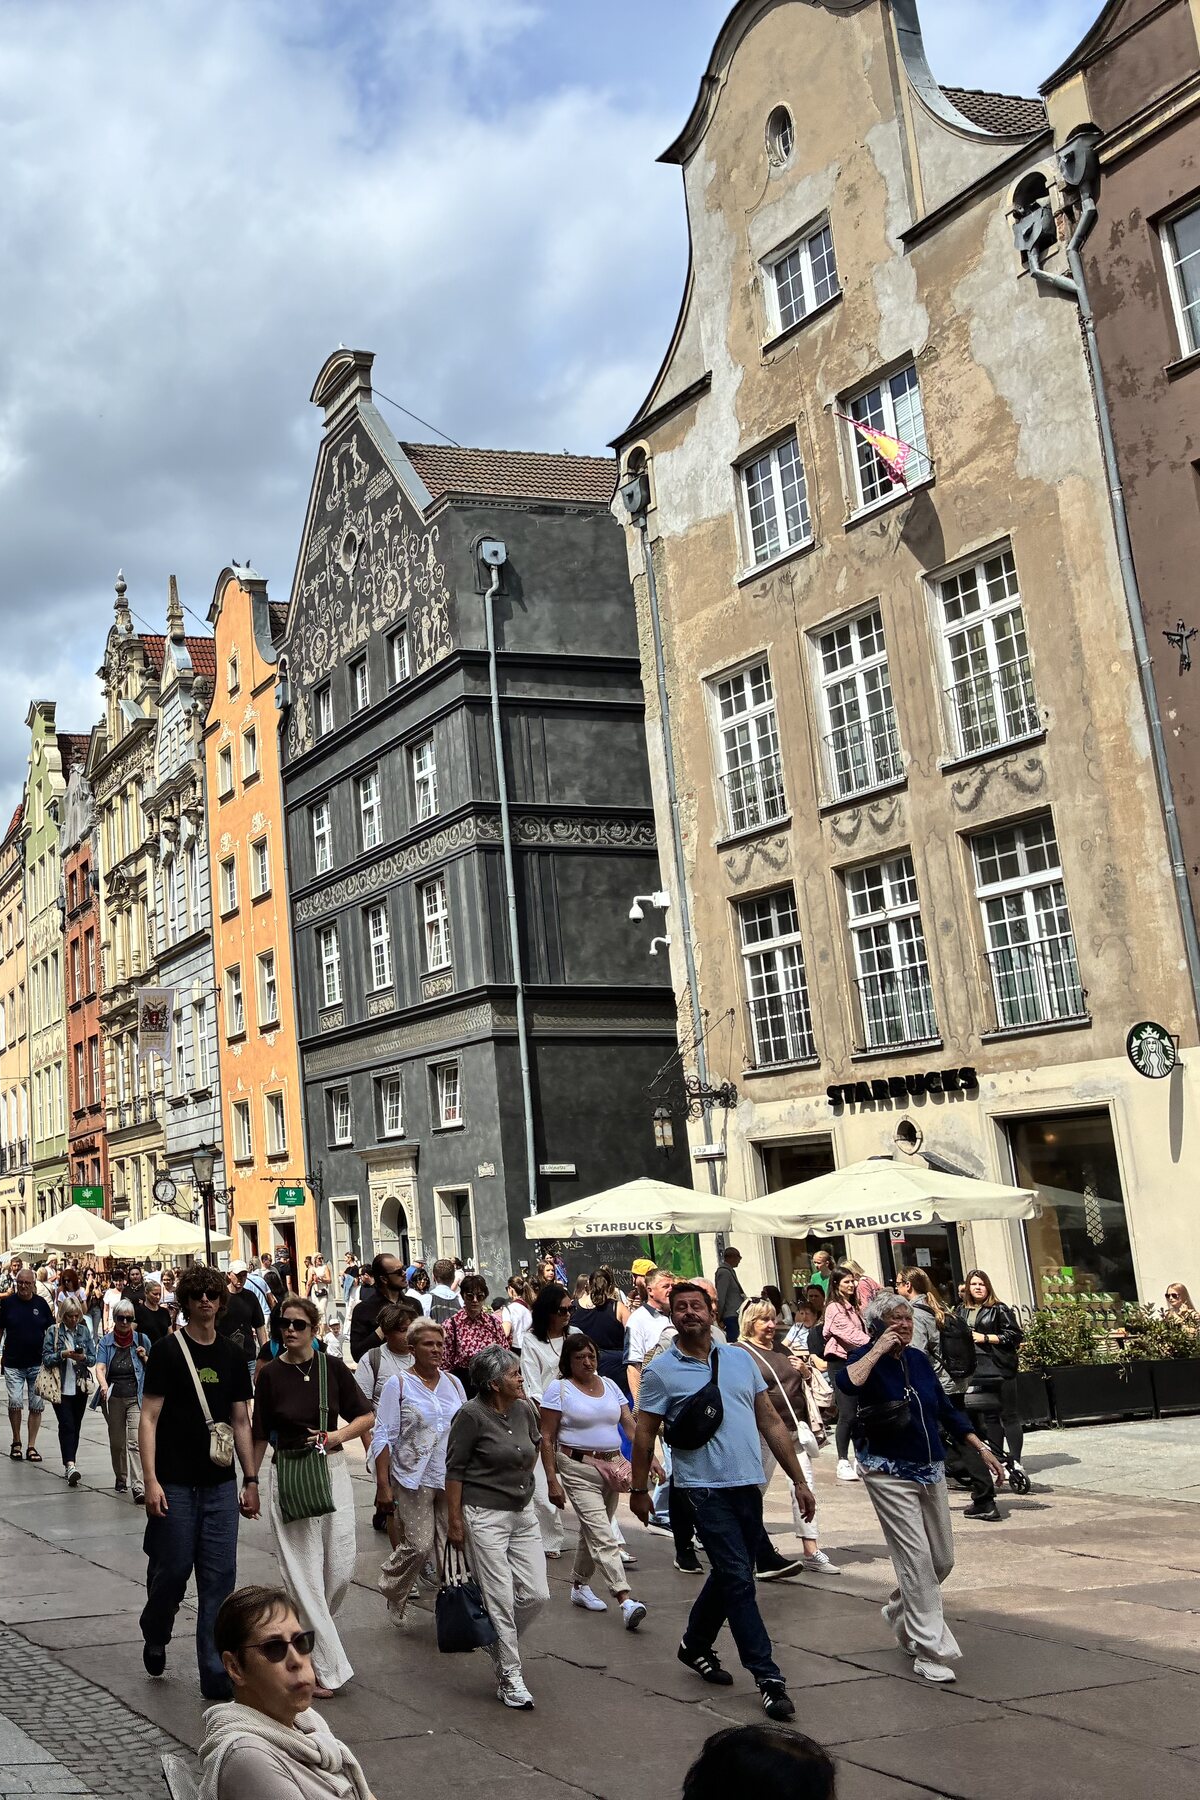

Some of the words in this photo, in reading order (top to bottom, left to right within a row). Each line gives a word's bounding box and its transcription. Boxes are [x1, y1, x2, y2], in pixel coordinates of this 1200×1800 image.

[826, 1067, 978, 1106] STARBUCKS
[585, 1221, 663, 1233] STARBUCKS
[825, 1210, 923, 1233] STARBUCKS
